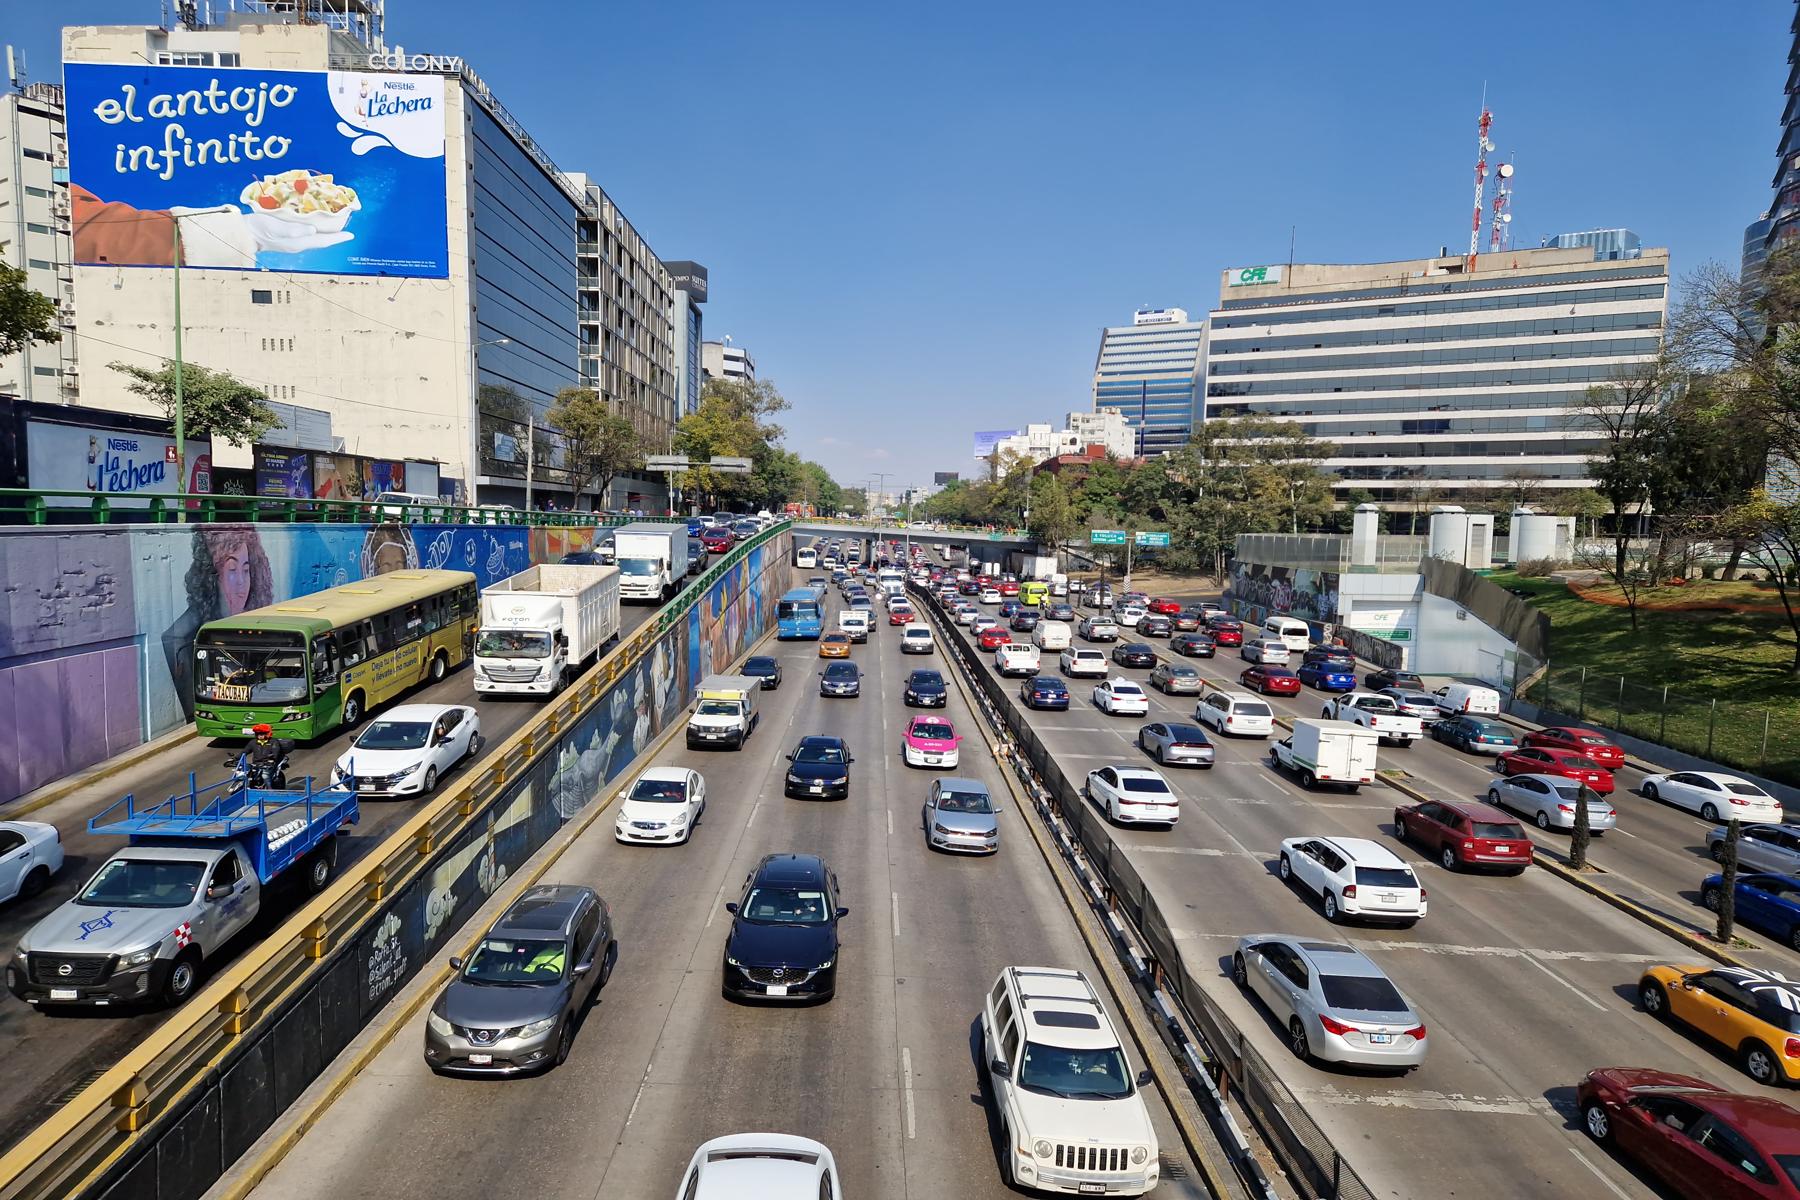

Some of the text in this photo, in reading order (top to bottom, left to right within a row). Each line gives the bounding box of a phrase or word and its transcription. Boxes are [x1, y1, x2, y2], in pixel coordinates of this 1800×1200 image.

[368, 53, 459, 71] COLONY
[93, 78, 298, 127] el antojo
[367, 96, 432, 118] Lechera
[375, 91, 388, 103] La
[115, 123, 292, 180] infinito
[691, 275, 707, 288] SUITES
[1240, 266, 1269, 282] CFE
[105, 451, 120, 473] La
